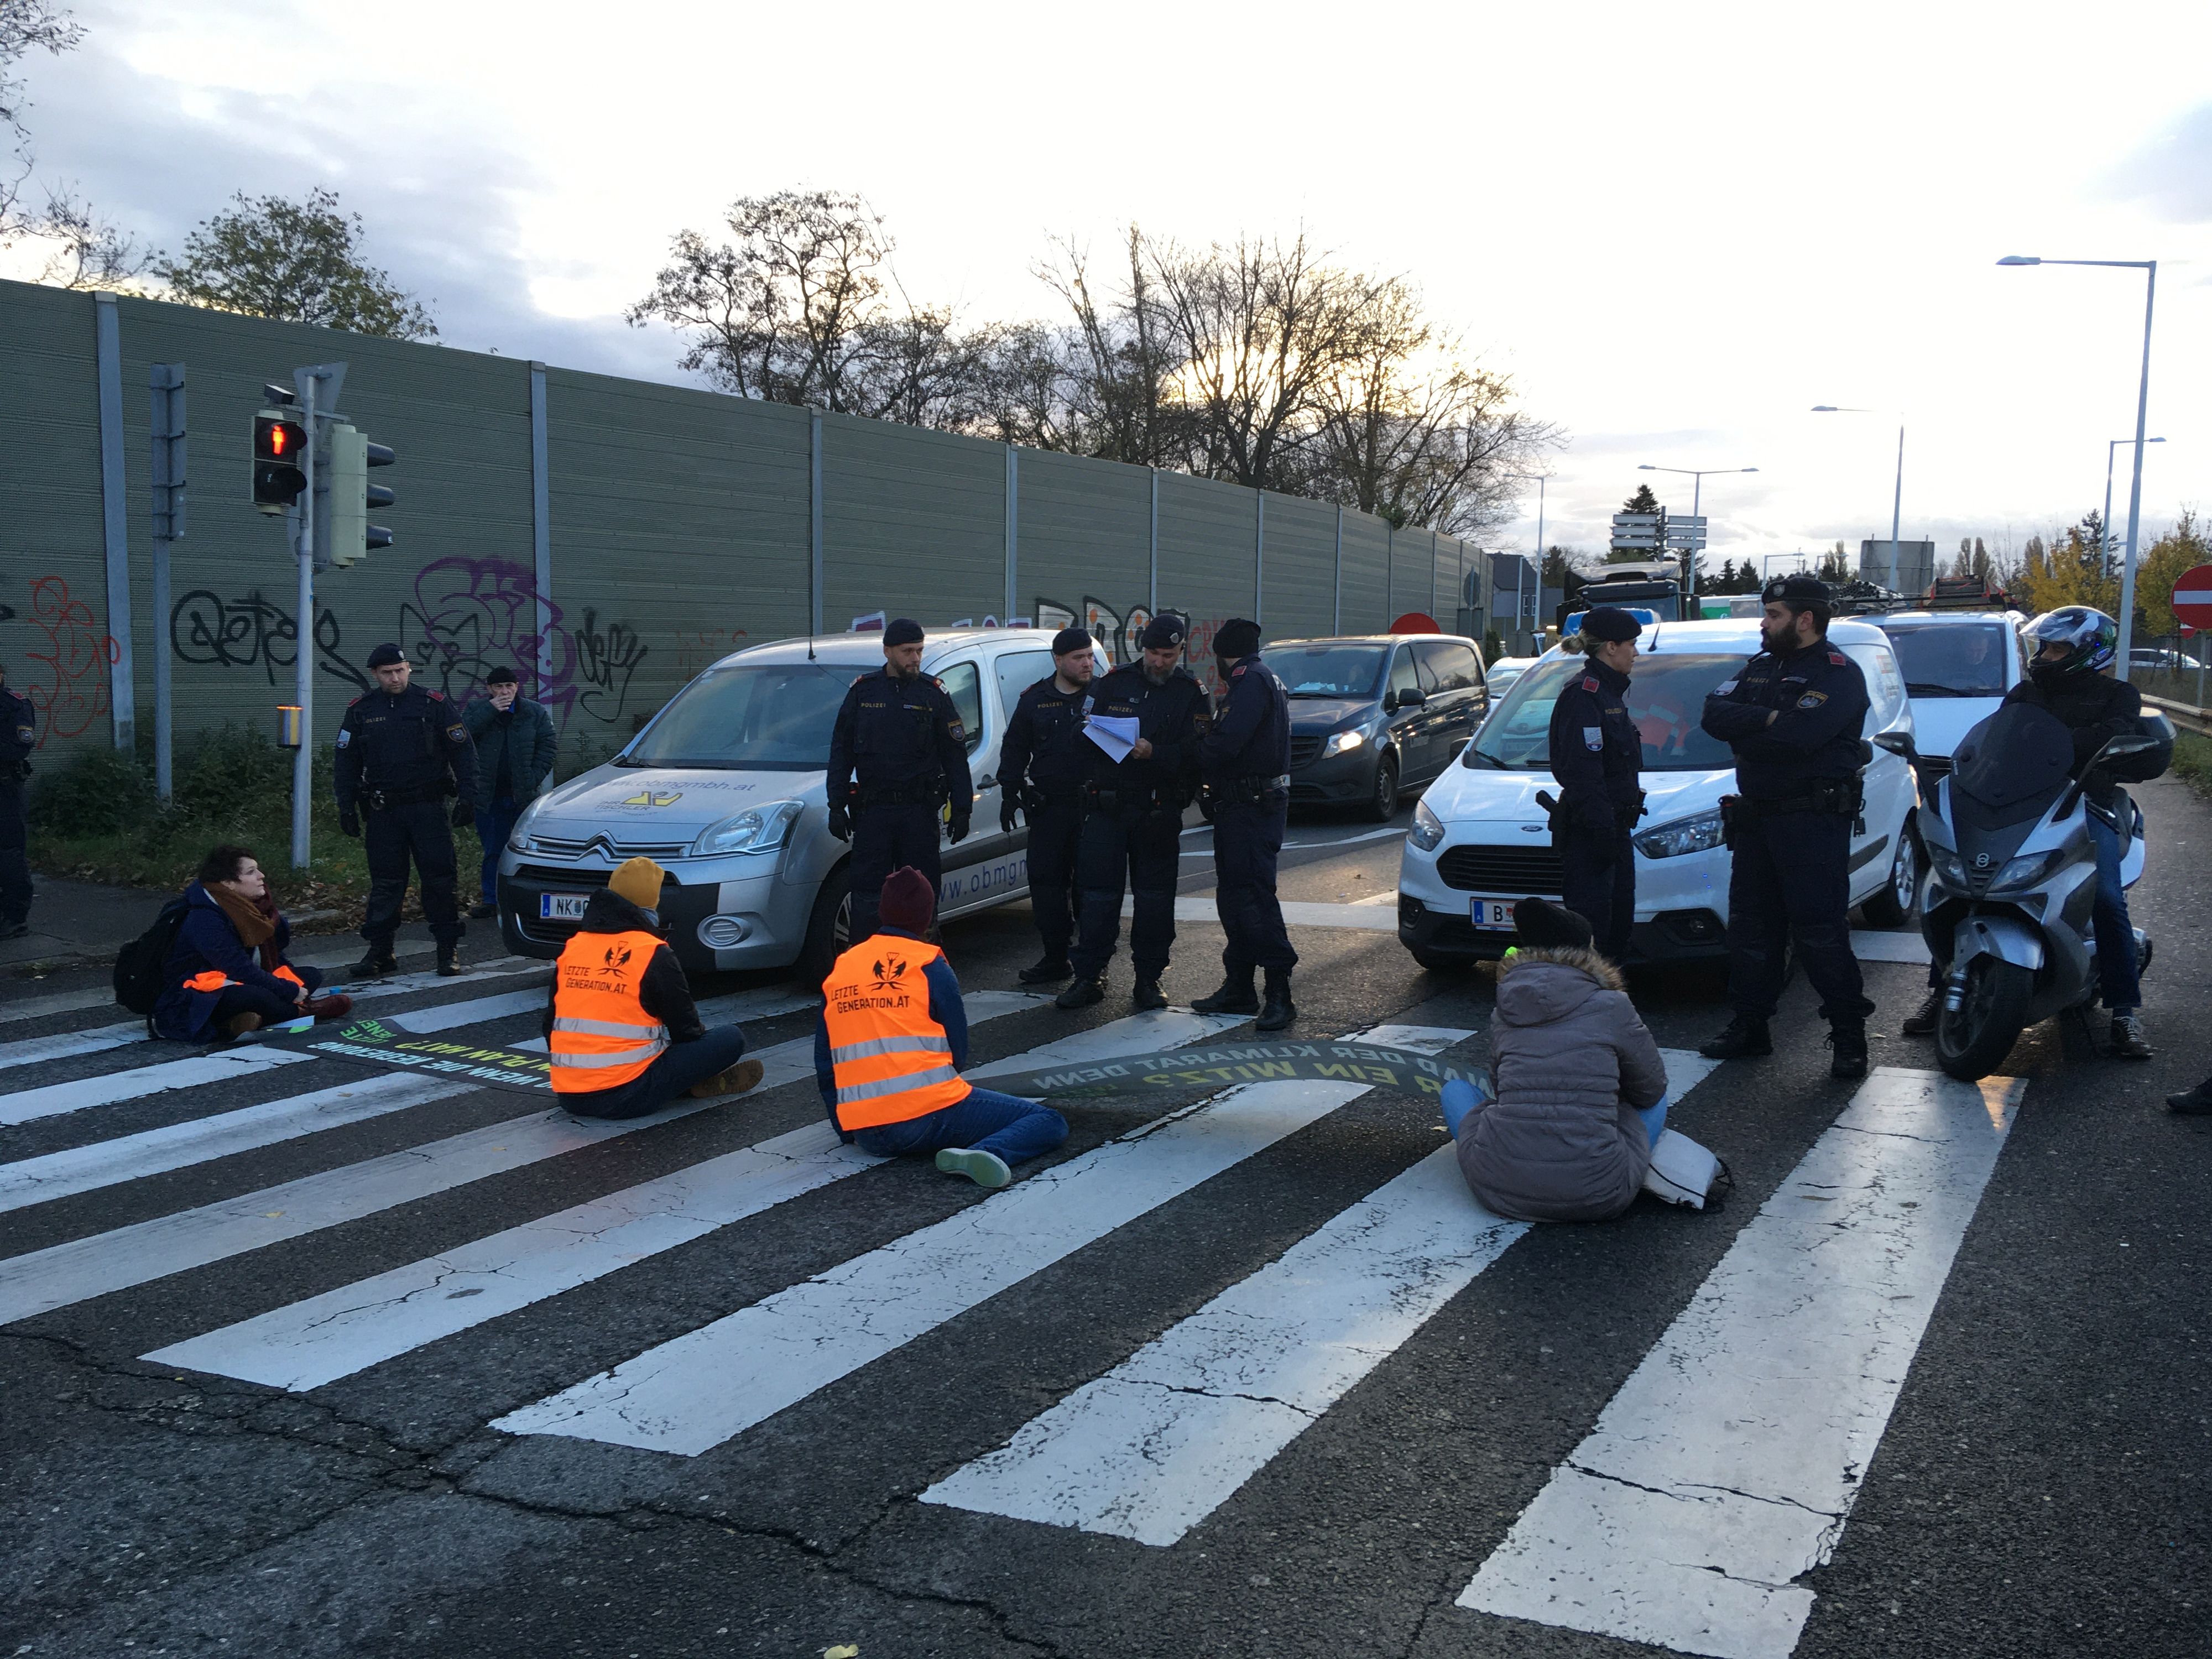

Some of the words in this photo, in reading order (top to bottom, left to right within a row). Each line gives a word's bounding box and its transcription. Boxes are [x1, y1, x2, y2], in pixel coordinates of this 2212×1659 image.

[1108, 705, 1133, 713] POLIZEI
[556, 898, 573, 915] NK
[1494, 905, 1503, 922] B
[564, 964, 591, 977] LETZTE
[566, 977, 627, 995] GENERATION.AT
[831, 984, 859, 1001] LETZTE
[837, 995, 910, 1014] GENERATION.AT
[307, 1042, 435, 1065] REGIERUNG
[394, 1040, 475, 1054] HAT?
[419, 1060, 474, 1072] DIE
[459, 1050, 542, 1067] PLAN
[460, 1066, 544, 1085] WENN
